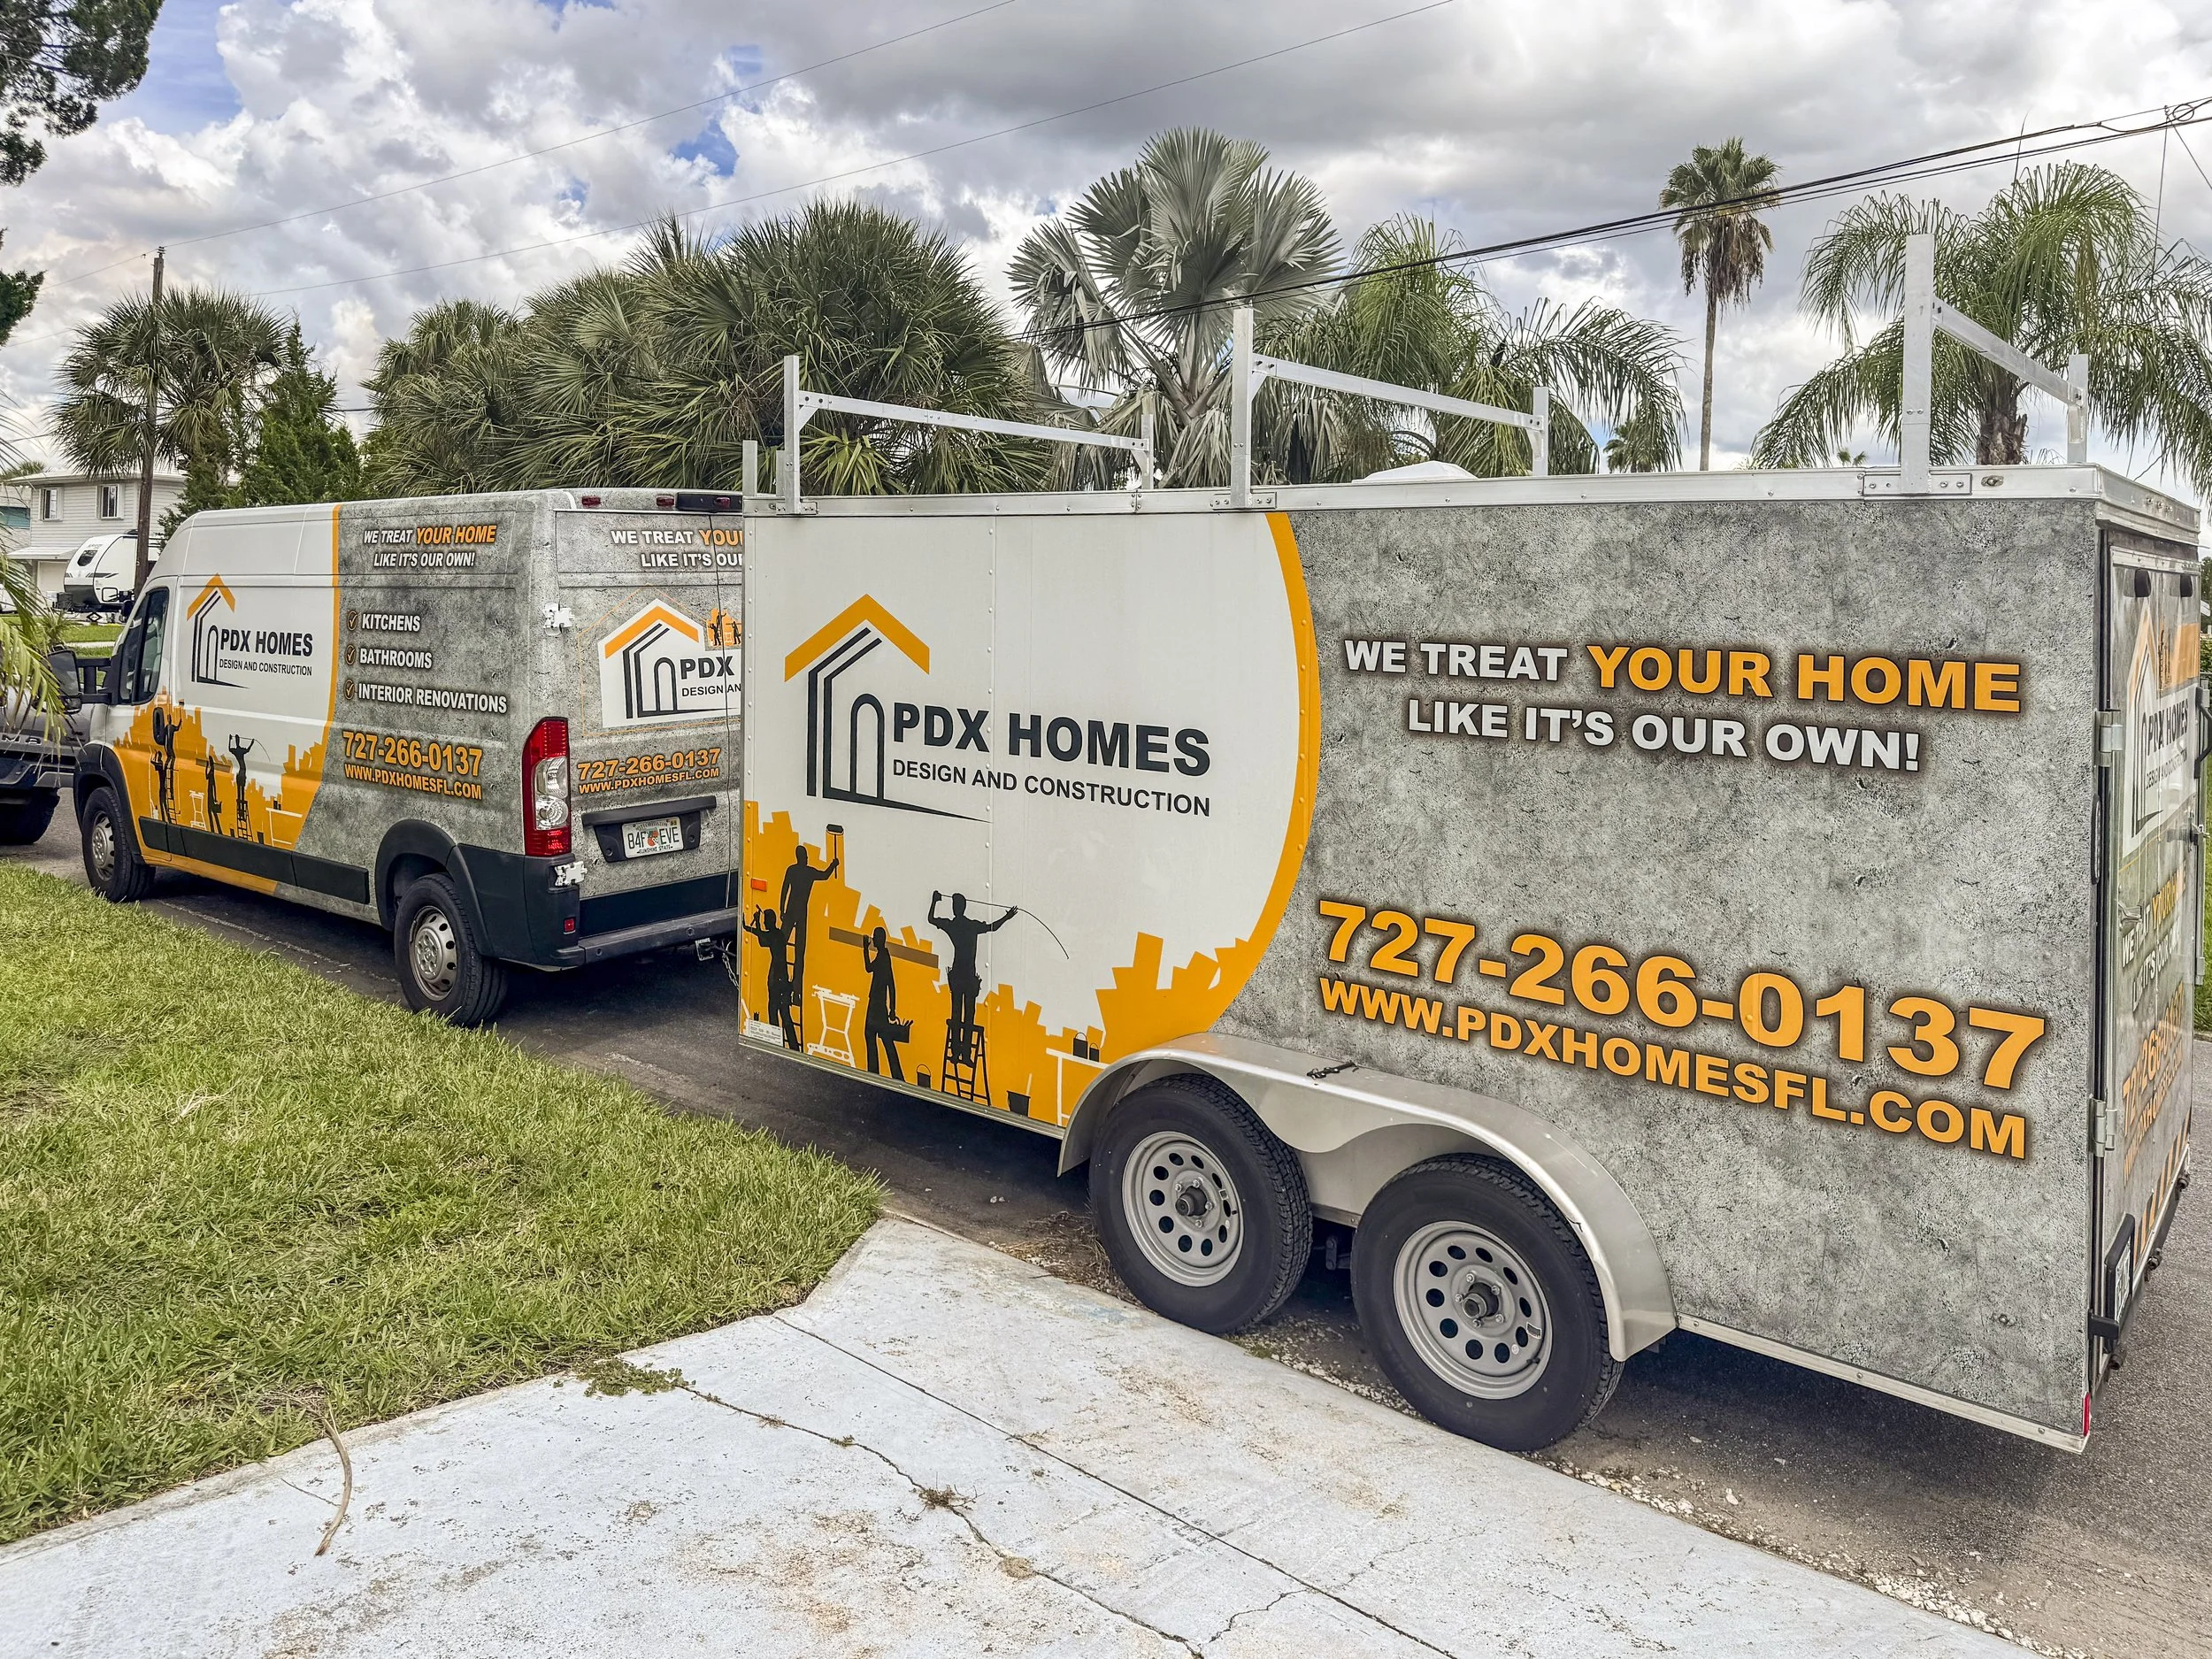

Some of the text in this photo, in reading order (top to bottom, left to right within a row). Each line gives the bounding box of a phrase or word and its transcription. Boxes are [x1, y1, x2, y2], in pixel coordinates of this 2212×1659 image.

[364, 525, 497, 545] WE TREAT YOUR HOME
[611, 529, 742, 546] WE TREAT YOU
[373, 552, 475, 567] LIKE IT'S OUR OWN!
[641, 553, 679, 567] LIKE
[683, 553, 712, 567] IT'S
[361, 613, 421, 633] KITCHENS
[220, 628, 313, 657] PDX HOMES
[219, 658, 312, 676] DESIGN AND CONSTRUCTION
[359, 649, 433, 670] BATHROOMS
[680, 656, 734, 680] PDX
[681, 683, 741, 696] DESIGN AN
[1344, 639, 2020, 713] WE TREAT YOUR HOME
[358, 682, 507, 714] INTERIOR RENOVATIONS
[893, 702, 1211, 778] PDX HOMES
[1408, 699, 1920, 772] LIKE IT'S OUR OWN!
[2147, 698, 2189, 757] PDX HOMES
[342, 731, 484, 777] 727-266-0137
[577, 748, 722, 781] 727-266-0137
[344, 764, 482, 801] WWW.PDXHOMESFL.COM
[579, 767, 720, 795] WWW.PDXHOMESFL.COM
[893, 758, 1211, 818] DESIGN AND CONSTRUCTION
[1319, 900, 2046, 1090] 727-266-0137
[1319, 977, 2026, 1160] WWW.PDXHOMESFL.COM
